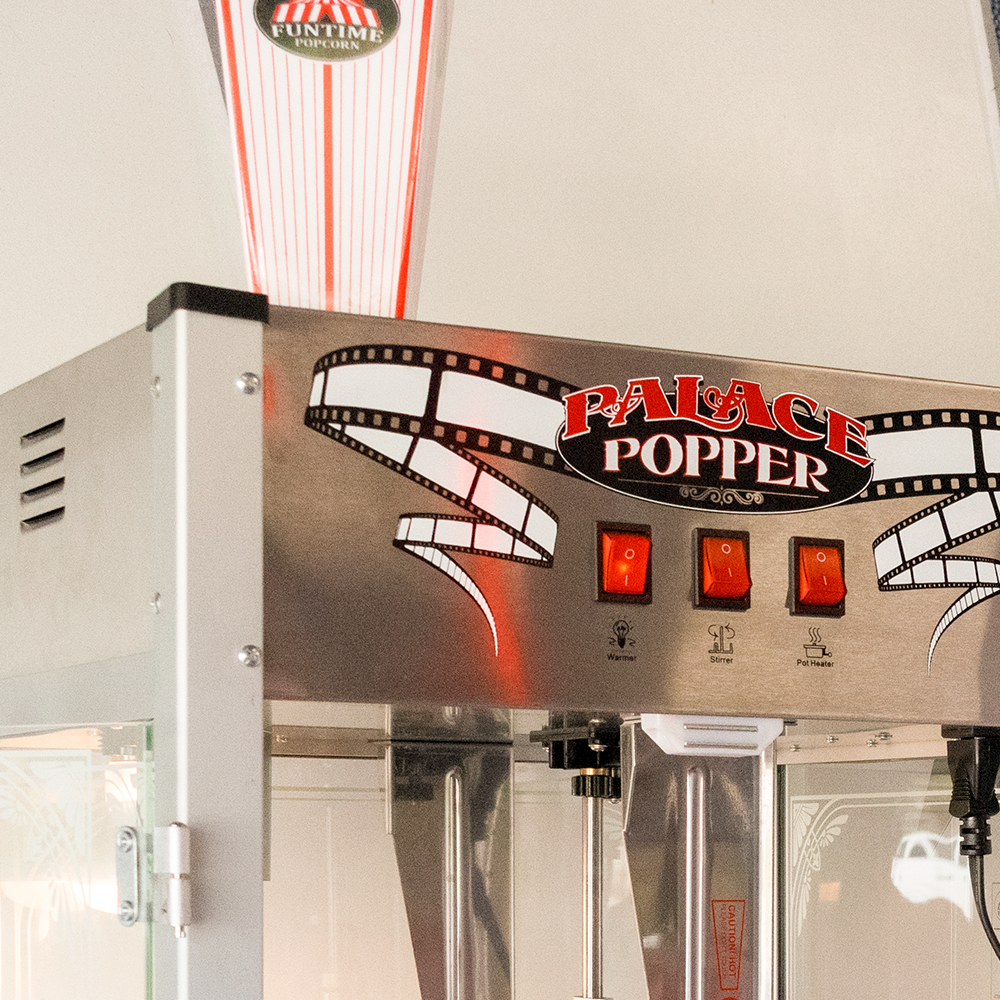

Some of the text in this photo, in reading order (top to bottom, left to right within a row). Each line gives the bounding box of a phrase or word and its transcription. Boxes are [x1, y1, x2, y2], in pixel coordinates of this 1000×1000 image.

[271, 23, 384, 43] FUNTIME
[295, 38, 360, 50] POPCORN
[561, 374, 877, 467] PALACE
[603, 433, 830, 493] POPPER
[607, 653, 637, 662] Warmer
[710, 655, 734, 664] Stirrer
[796, 659, 834, 668] Pot Heater
[728, 956, 737, 979] HOT
